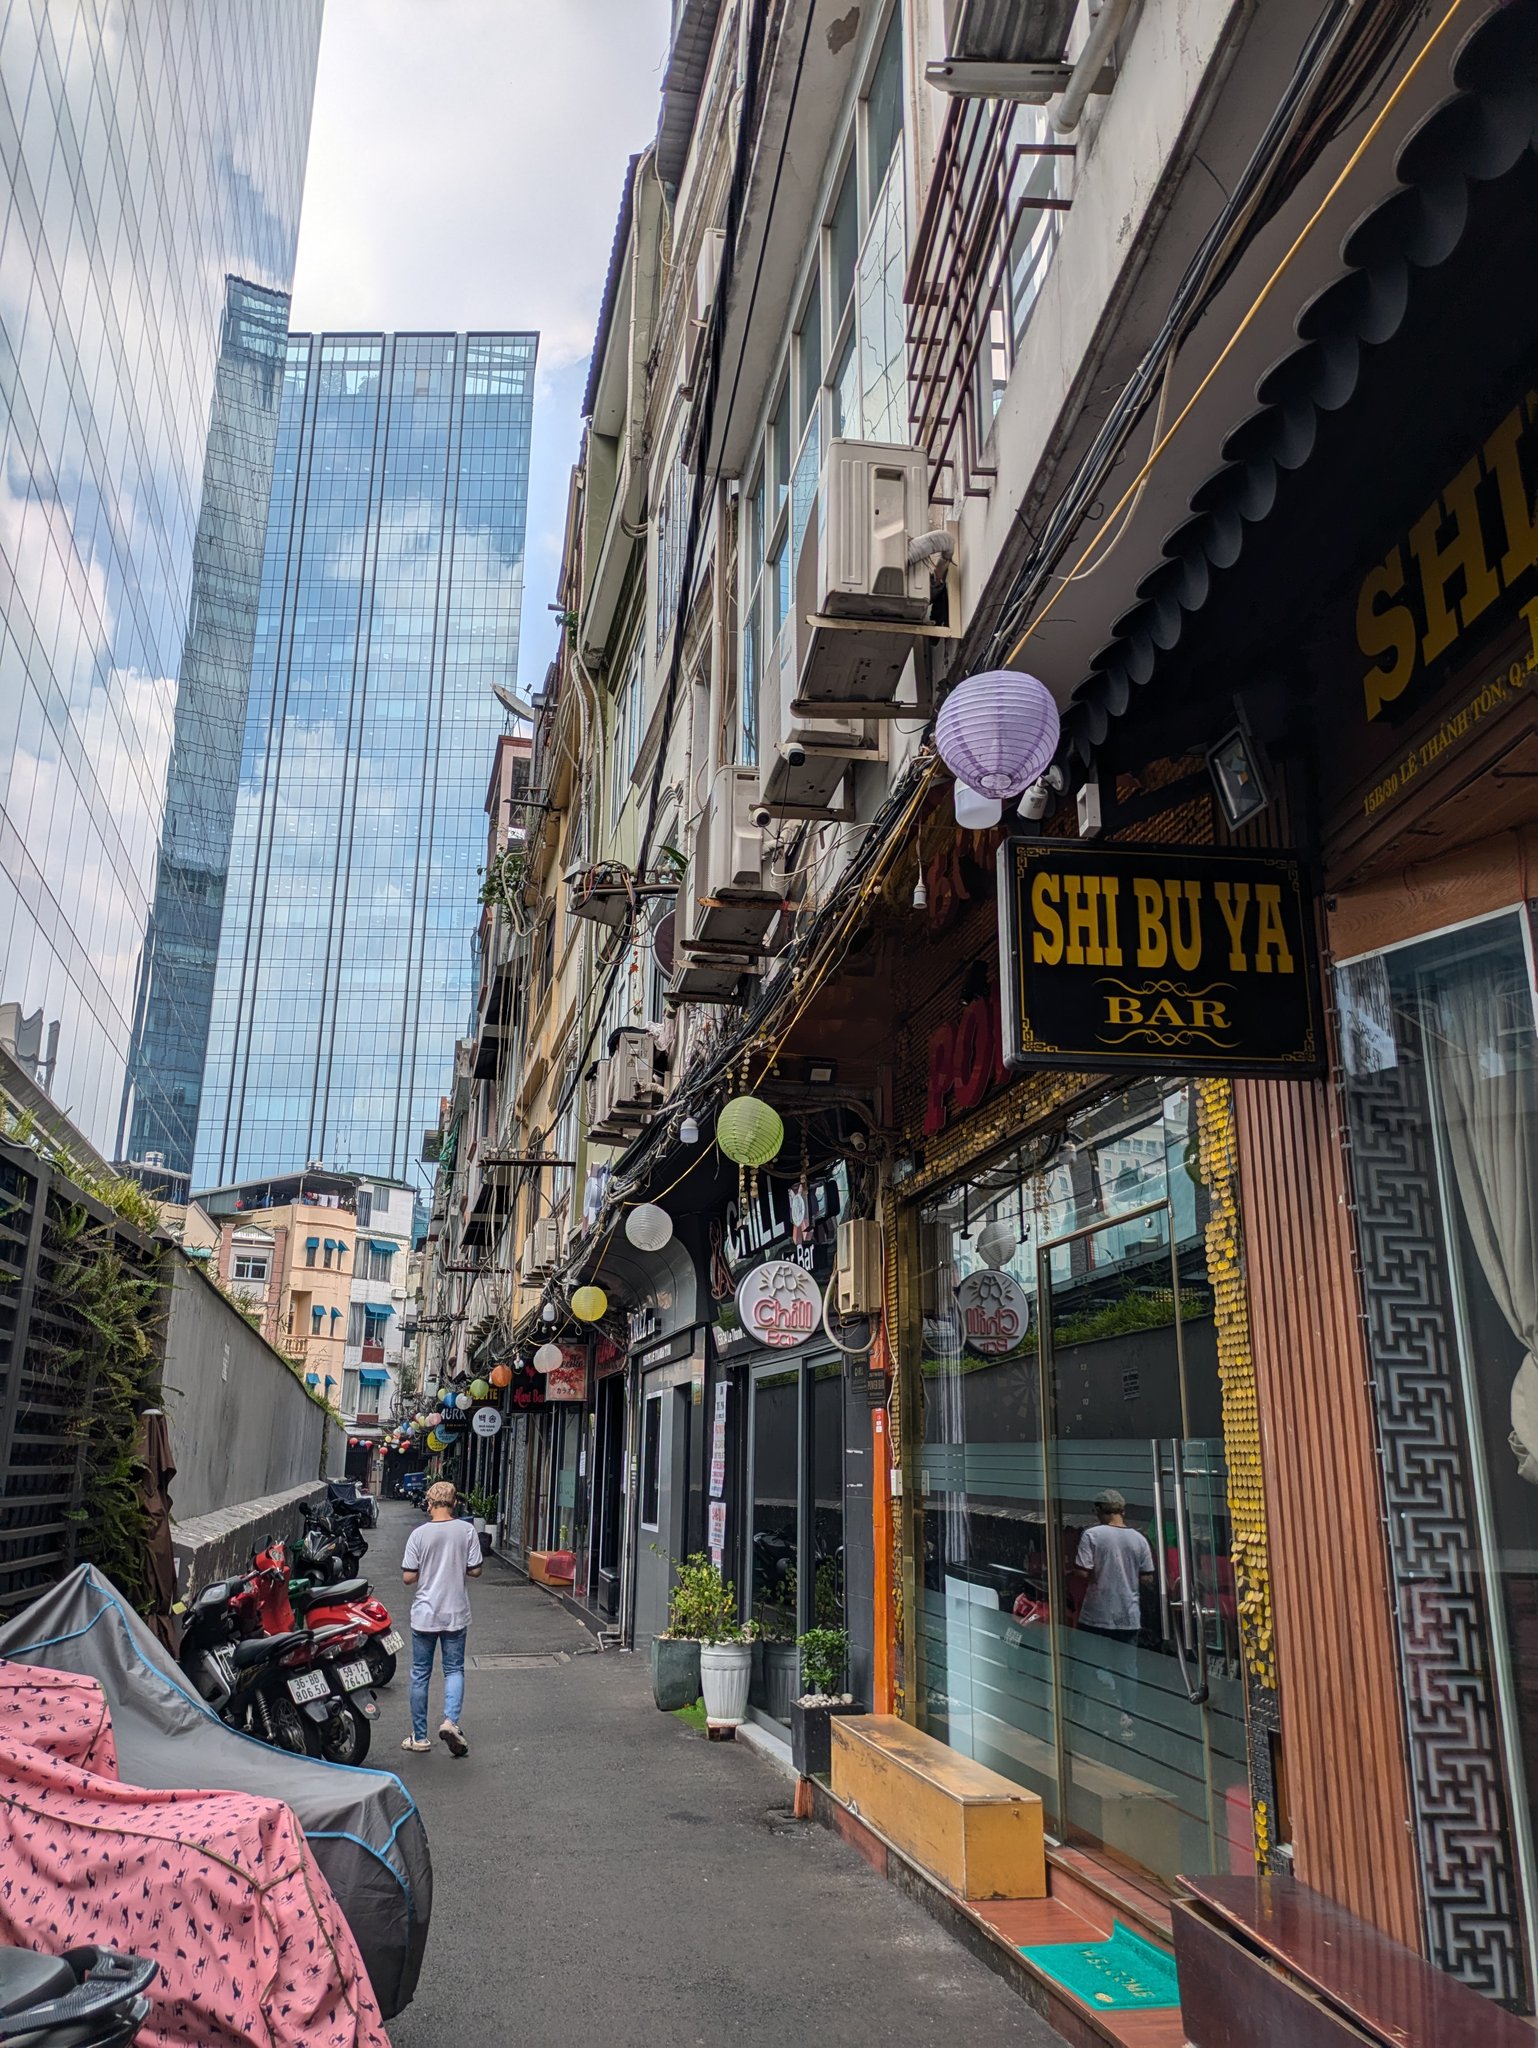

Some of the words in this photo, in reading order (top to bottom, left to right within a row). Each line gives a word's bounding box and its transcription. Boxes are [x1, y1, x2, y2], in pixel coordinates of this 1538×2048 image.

[1363, 774, 1398, 817] 15B/30
[1399, 750, 1418, 786] LÊ
[1031, 871, 1125, 967] SHI
[1132, 877, 1204, 972] BU
[1214, 881, 1295, 975] YA
[1103, 996, 1232, 1029] BAR
[797, 1243, 815, 1272] Bar
[753, 1297, 814, 1329] Chill
[766, 1330, 800, 1347] Bar
[342, 1662, 365, 1678] 59-T2
[344, 1673, 371, 1690] 264.17
[295, 1683, 327, 1702] 806.50
